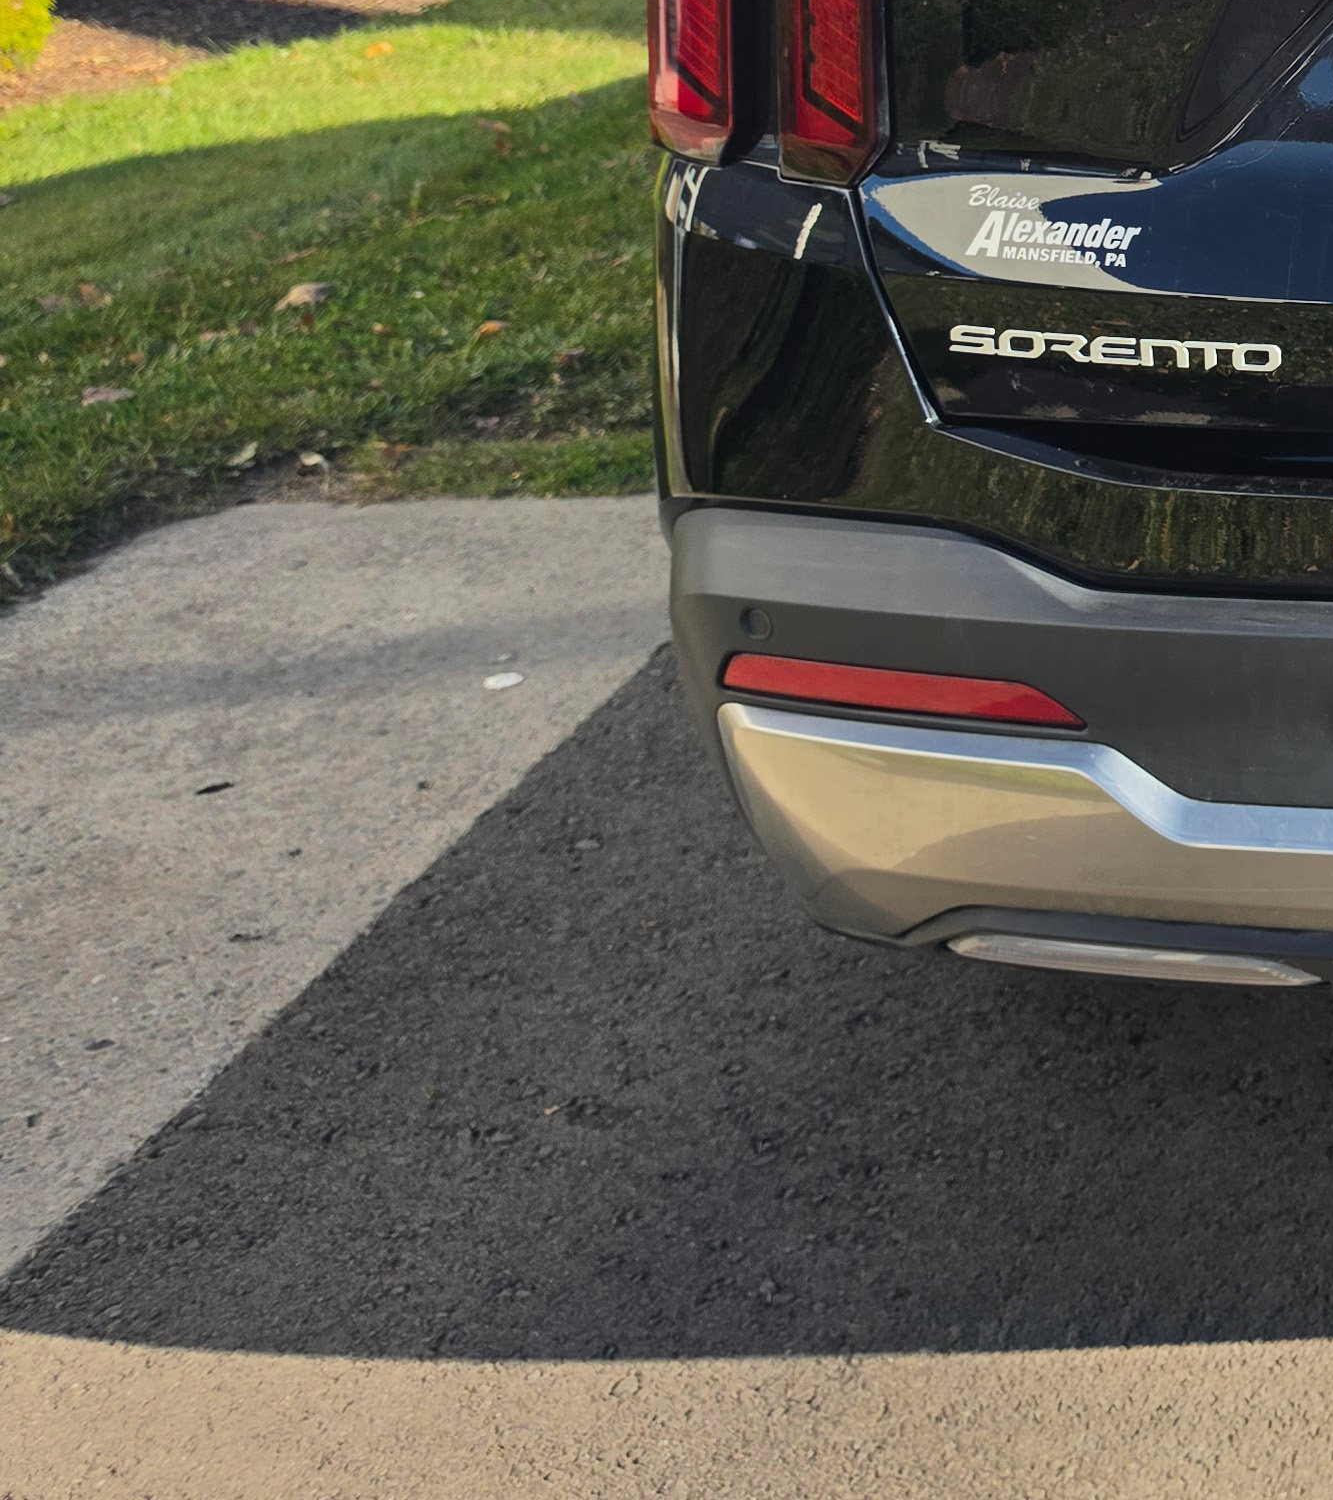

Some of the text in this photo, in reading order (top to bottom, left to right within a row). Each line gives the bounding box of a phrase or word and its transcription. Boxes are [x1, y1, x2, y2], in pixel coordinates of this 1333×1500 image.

[969, 184, 1040, 211] Blaise
[965, 210, 1143, 258] Alexander
[1001, 246, 1127, 268] MANSFIELD, PA
[948, 324, 1283, 373] SORENTO
